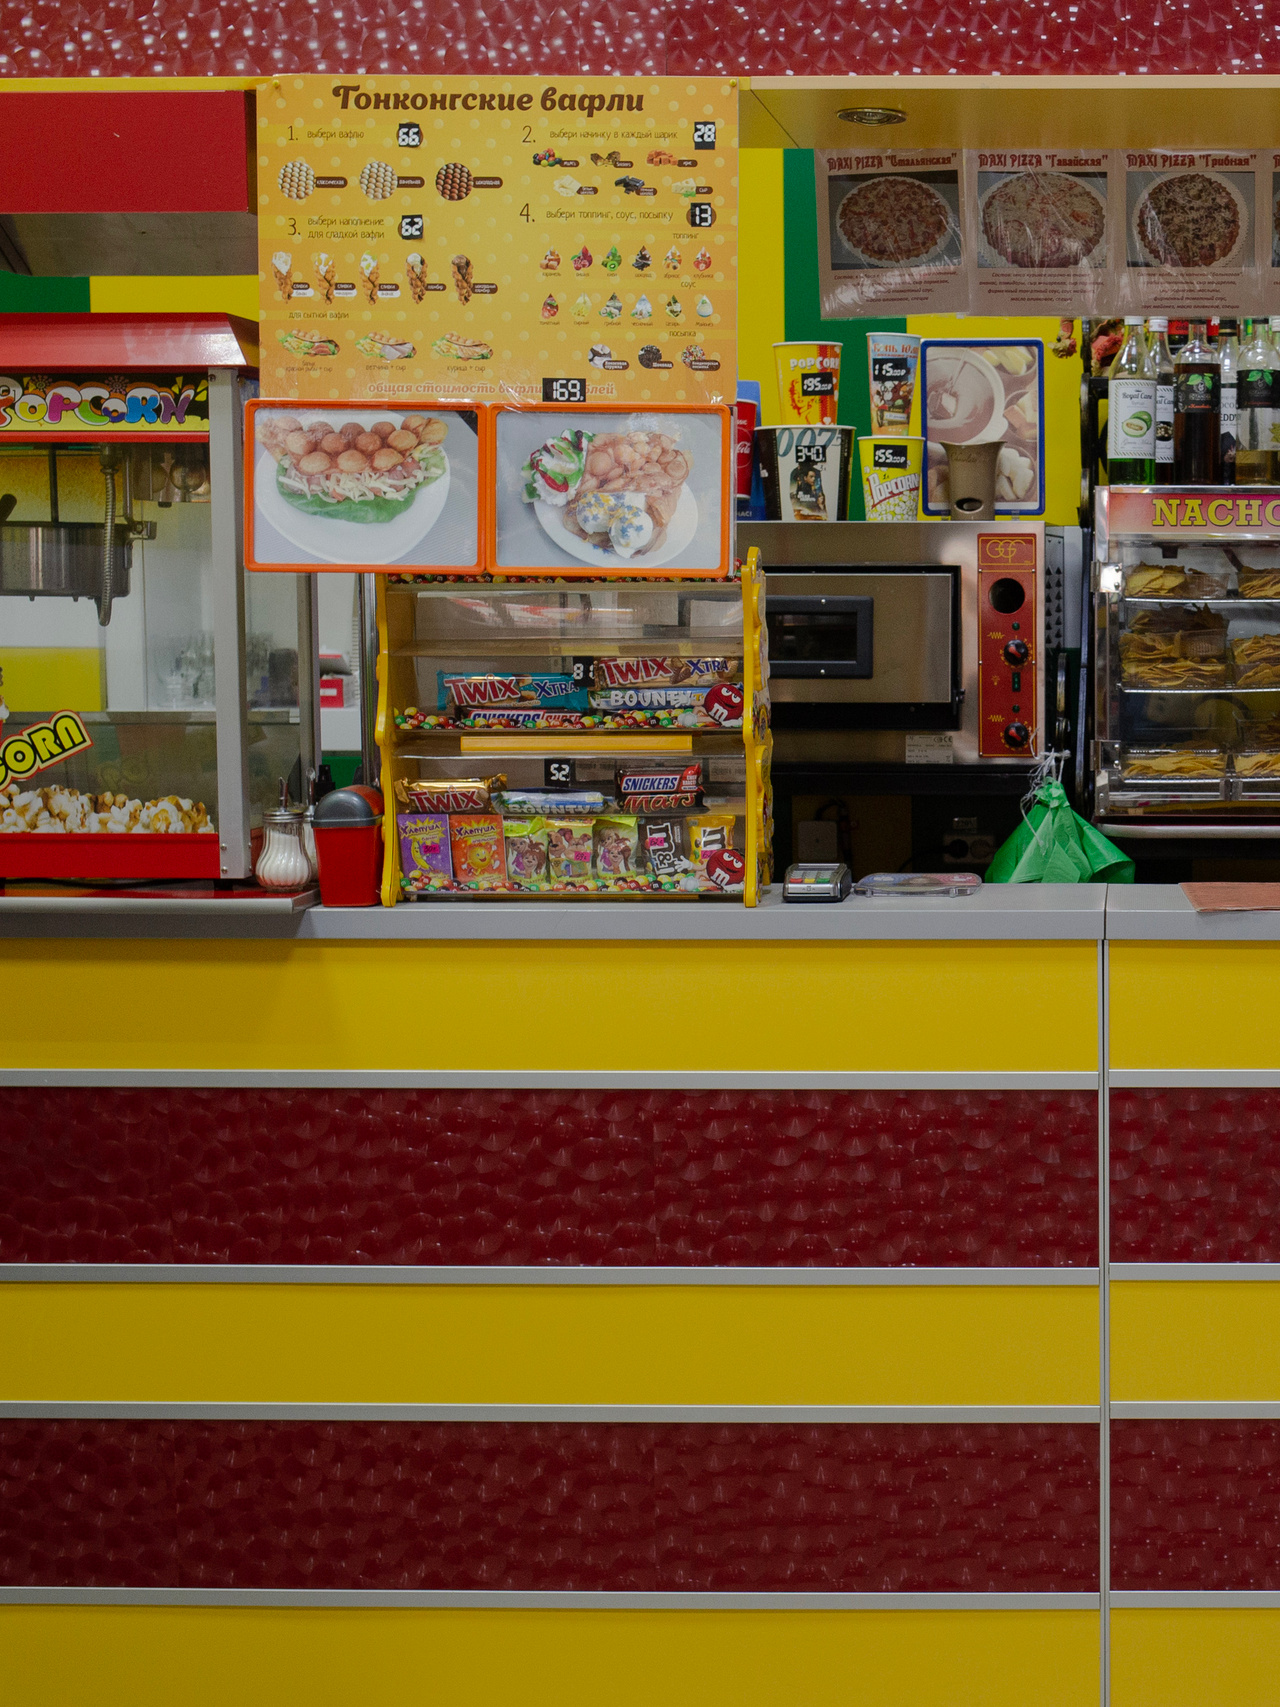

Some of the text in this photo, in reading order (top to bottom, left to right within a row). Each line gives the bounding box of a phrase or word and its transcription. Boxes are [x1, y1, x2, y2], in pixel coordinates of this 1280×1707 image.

[540, 86, 644, 118] вафли
[287, 125, 299, 141] 1.
[307, 128, 336, 139] выбери
[338, 129, 365, 140] вафлю
[521, 125, 536, 144] 2.
[549, 128, 578, 139] выбери
[580, 129, 611, 140] начинку
[621, 127, 653, 140] каждый
[654, 130, 678, 140] шарик
[855, 156, 883, 170] PIZZA
[1010, 153, 1043, 168] PIZZA
[1159, 153, 1196, 170] PIZZA
[519, 203, 536, 223] 4.
[546, 209, 576, 220] выбери
[578, 211, 613, 221] топпинг,
[615, 211, 636, 221] соус,
[639, 211, 674, 222] посыпку
[288, 217, 385, 236] 3. выбери наполнение
[307, 229, 385, 241] для сладкой вафли
[672, 232, 699, 240] топпинг
[680, 281, 697, 289] соус
[288, 310, 350, 320] для сытной вафли
[669, 330, 697, 338] посыпка
[368, 382, 413, 394] общая
[415, 380, 496, 394] стоимость
[598, 657, 729, 686] TWIX XTRA
[444, 676, 580, 707] TWIX XTRA
[621, 774, 680, 792] SNICKERS
[407, 788, 483, 814] TWIX
[622, 792, 697, 813] Mars
